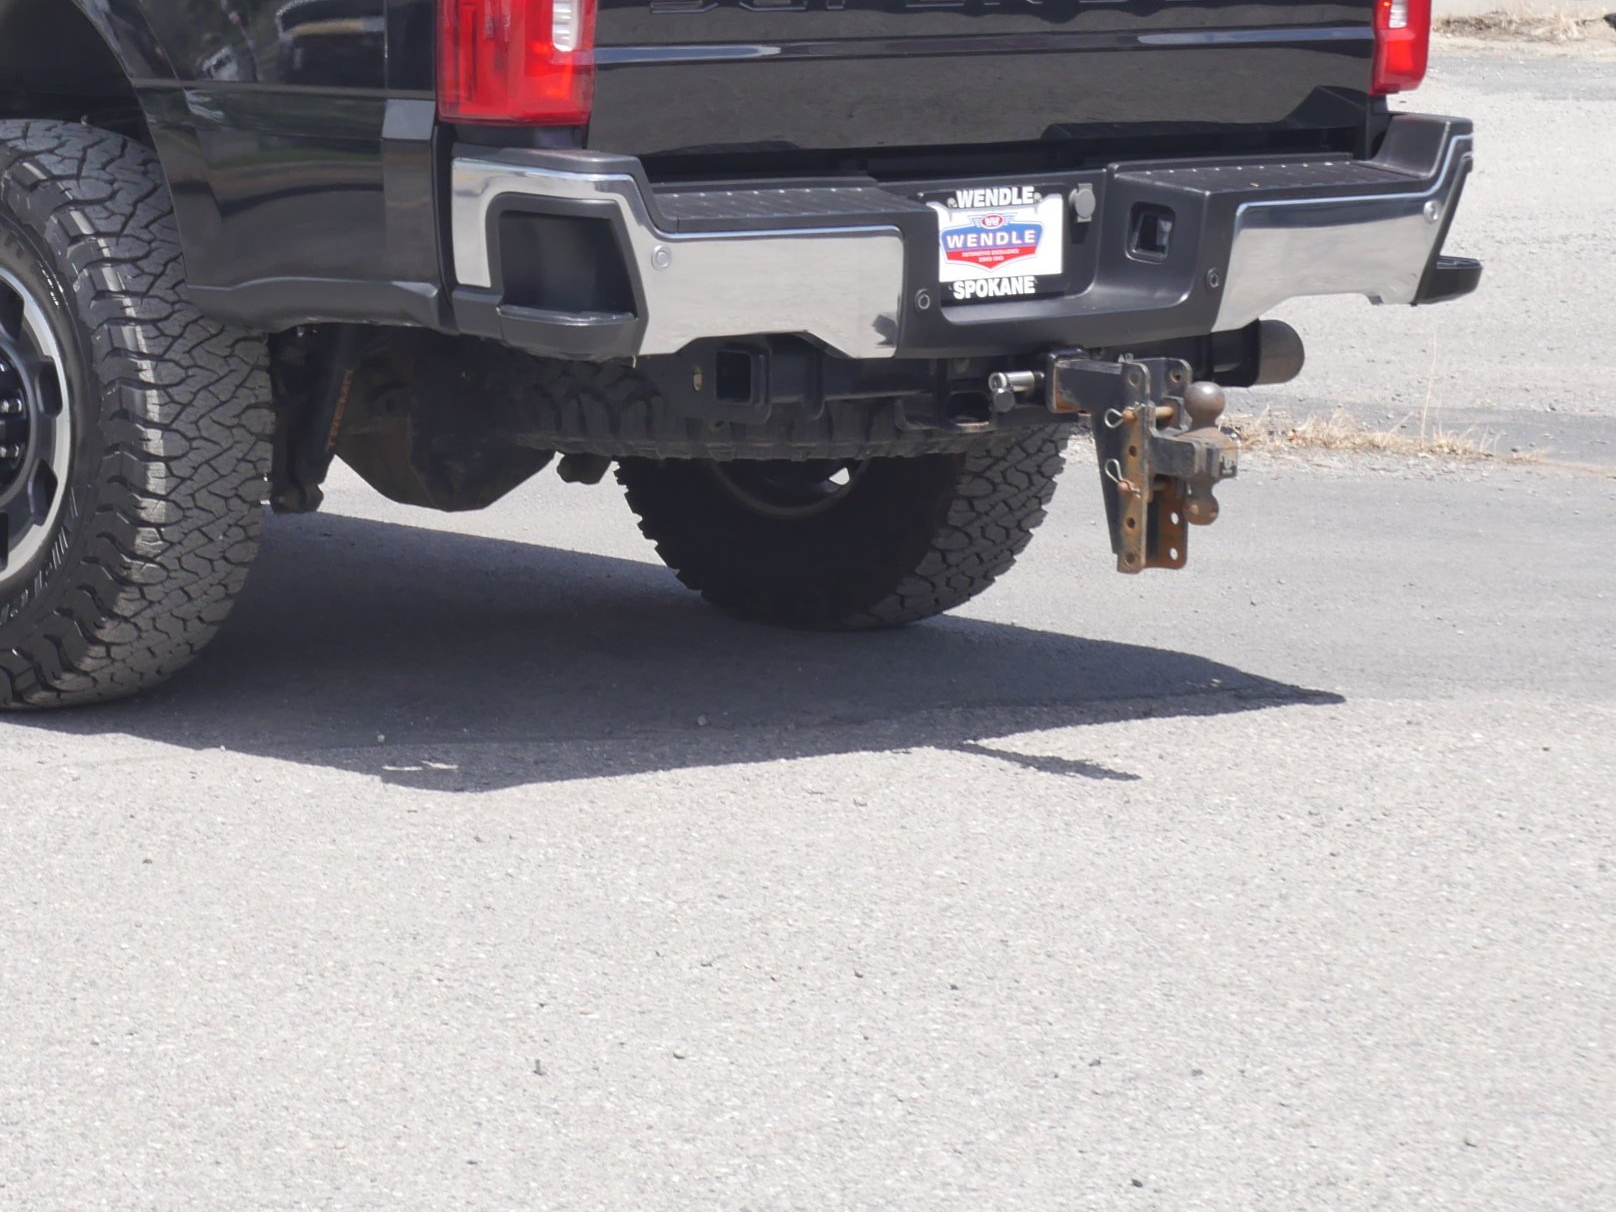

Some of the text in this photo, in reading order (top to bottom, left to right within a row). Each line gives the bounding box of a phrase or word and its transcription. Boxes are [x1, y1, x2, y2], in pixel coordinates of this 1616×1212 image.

[956, 186, 1035, 209] WENDLE
[946, 230, 1036, 249] WENDLE
[954, 277, 1036, 300] SPOKANE
